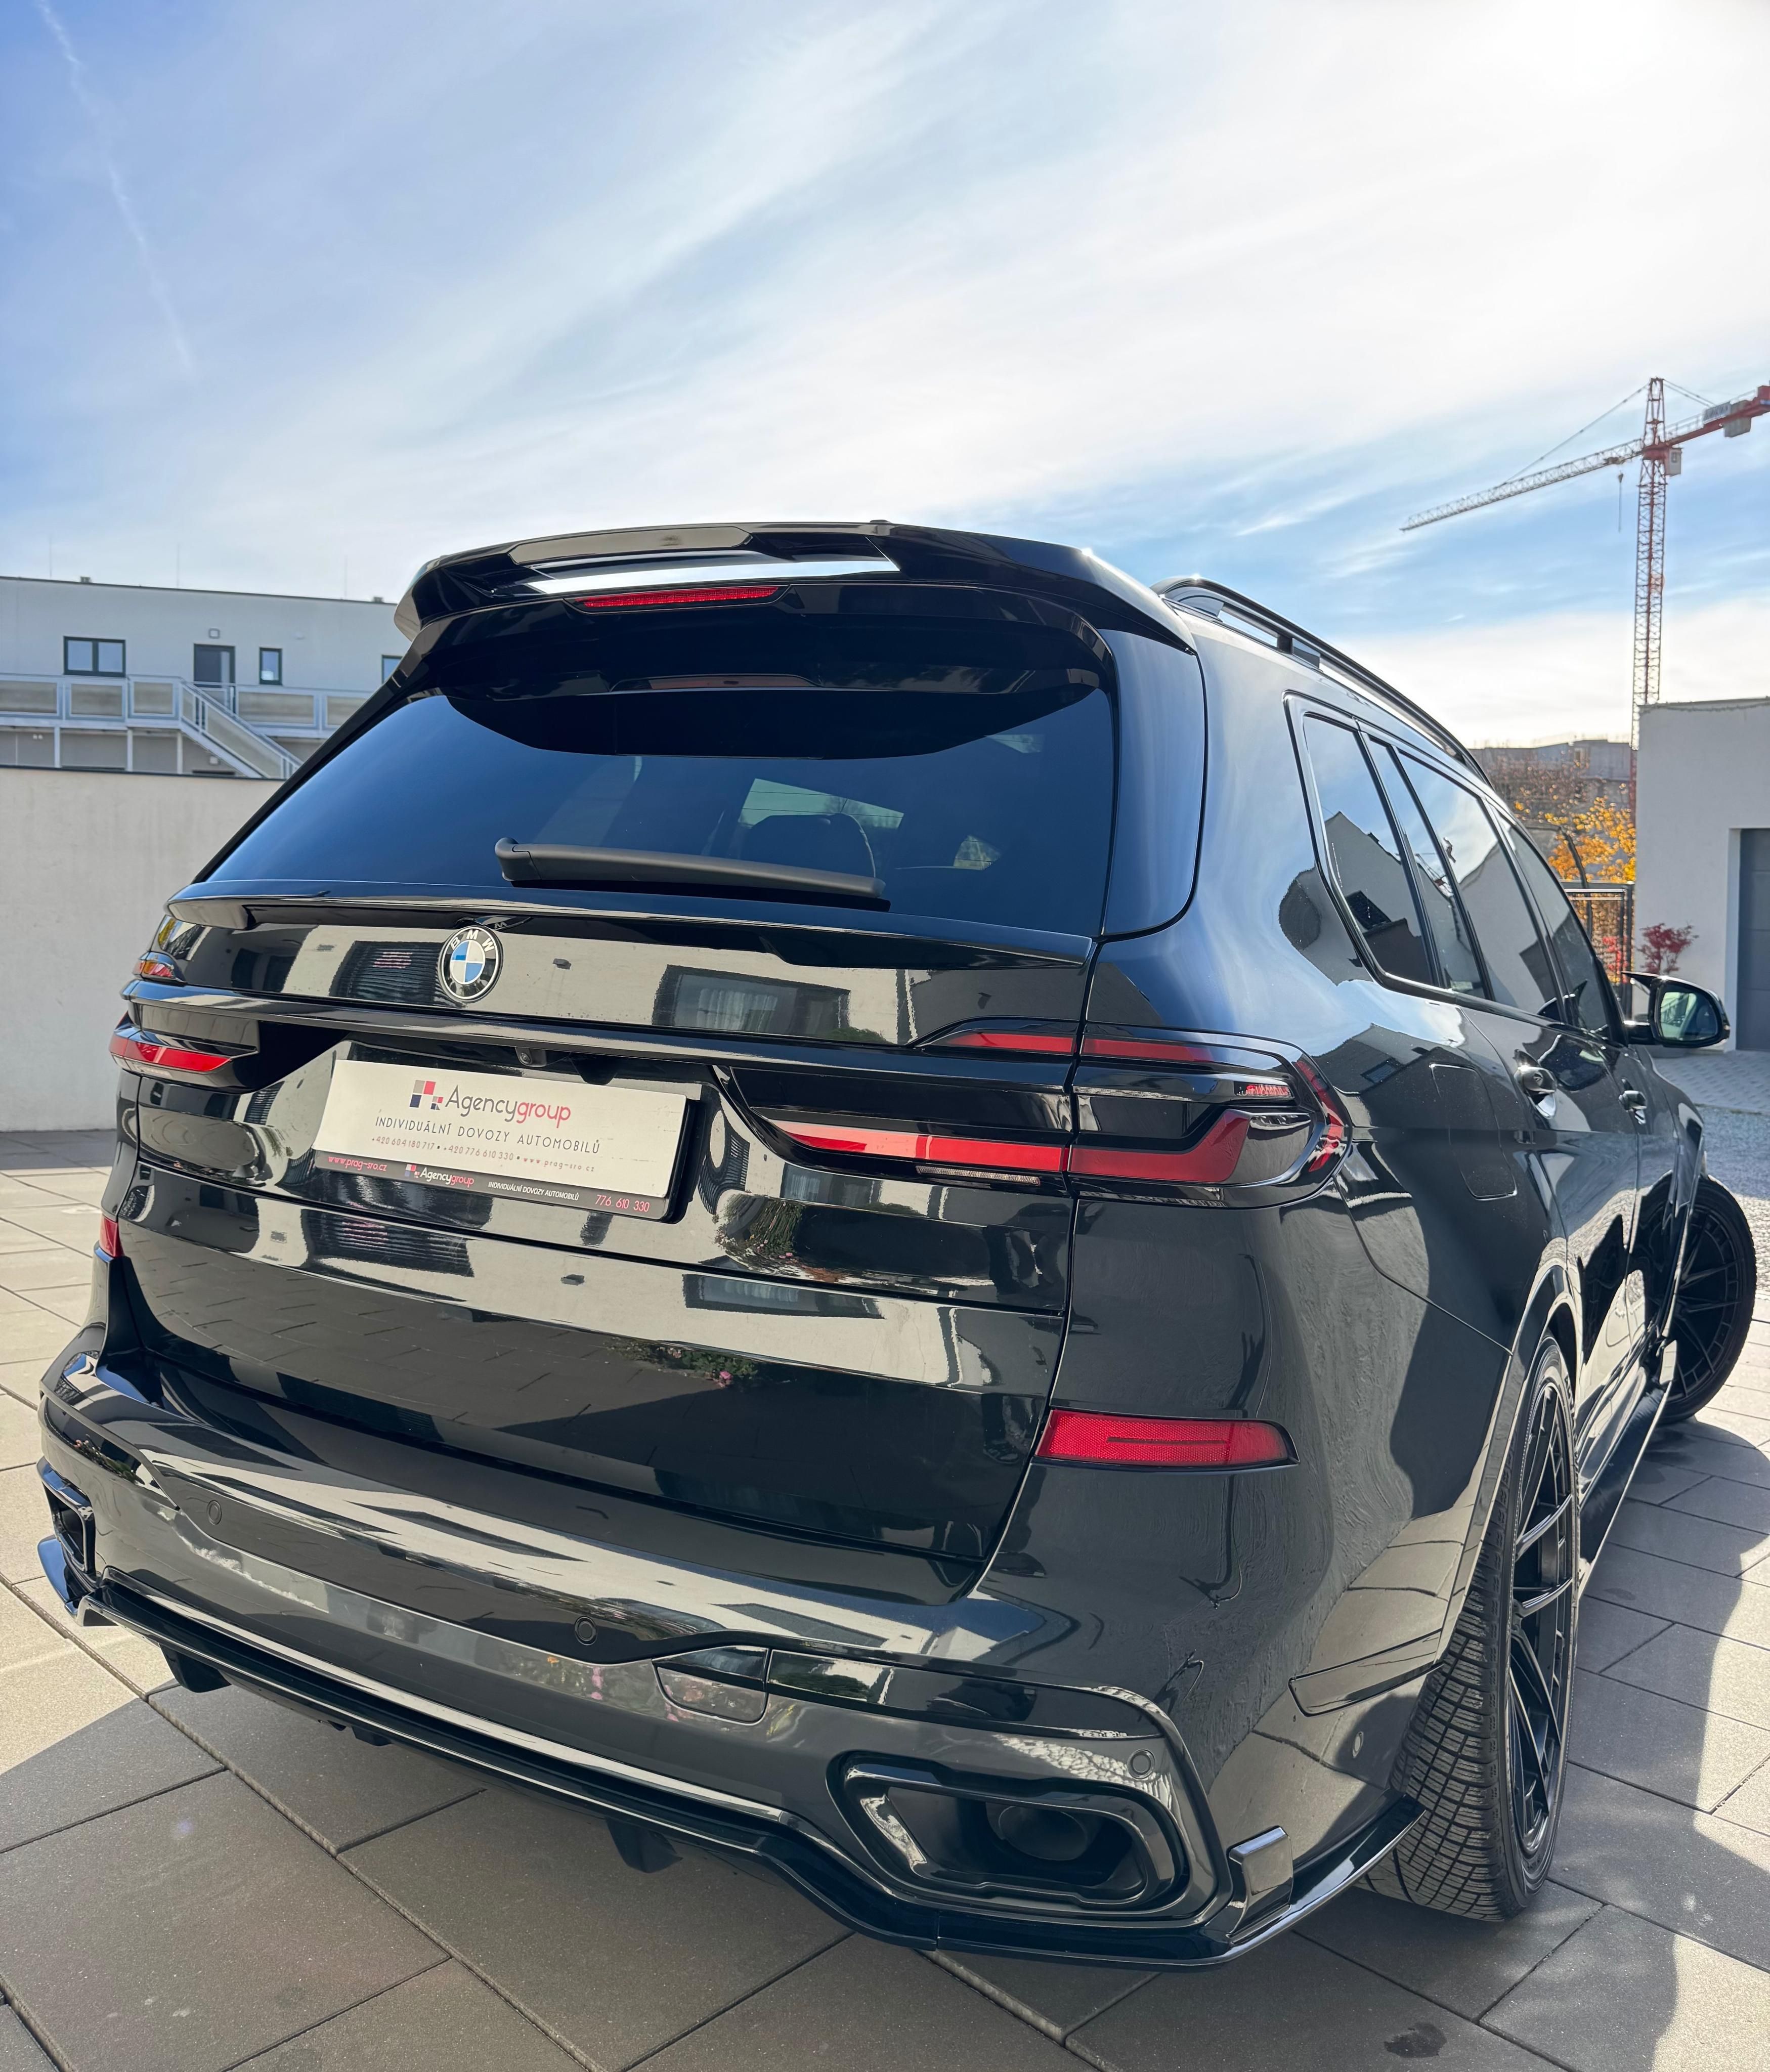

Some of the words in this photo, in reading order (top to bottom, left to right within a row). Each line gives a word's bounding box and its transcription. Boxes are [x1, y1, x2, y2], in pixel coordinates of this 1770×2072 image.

[450, 929, 495, 952] BMW
[445, 1085, 571, 1129] Agencygroup
[375, 1116, 452, 1135] INDIVIDUÁLNÍ
[458, 1126, 510, 1142] DOVOZY
[517, 1134, 600, 1153] AUTOMOBILŮ
[423, 1142, 435, 1150] 717
[465, 1147, 480, 1156] 776
[483, 1149, 496, 1158] 610
[498, 1151, 513, 1160] 330
[328, 1156, 387, 1171] www.prag-sro.cz
[420, 1167, 474, 1188] Agencygroup
[488, 1181, 523, 1193] INDIVIDUÁLNÍ
[523, 1186, 544, 1195] DOVOZY
[545, 1189, 579, 1200] AUTOMOBILŮ
[595, 1194, 612, 1206] 776
[616, 1198, 630, 1209] 610
[633, 1200, 650, 1212] 330
